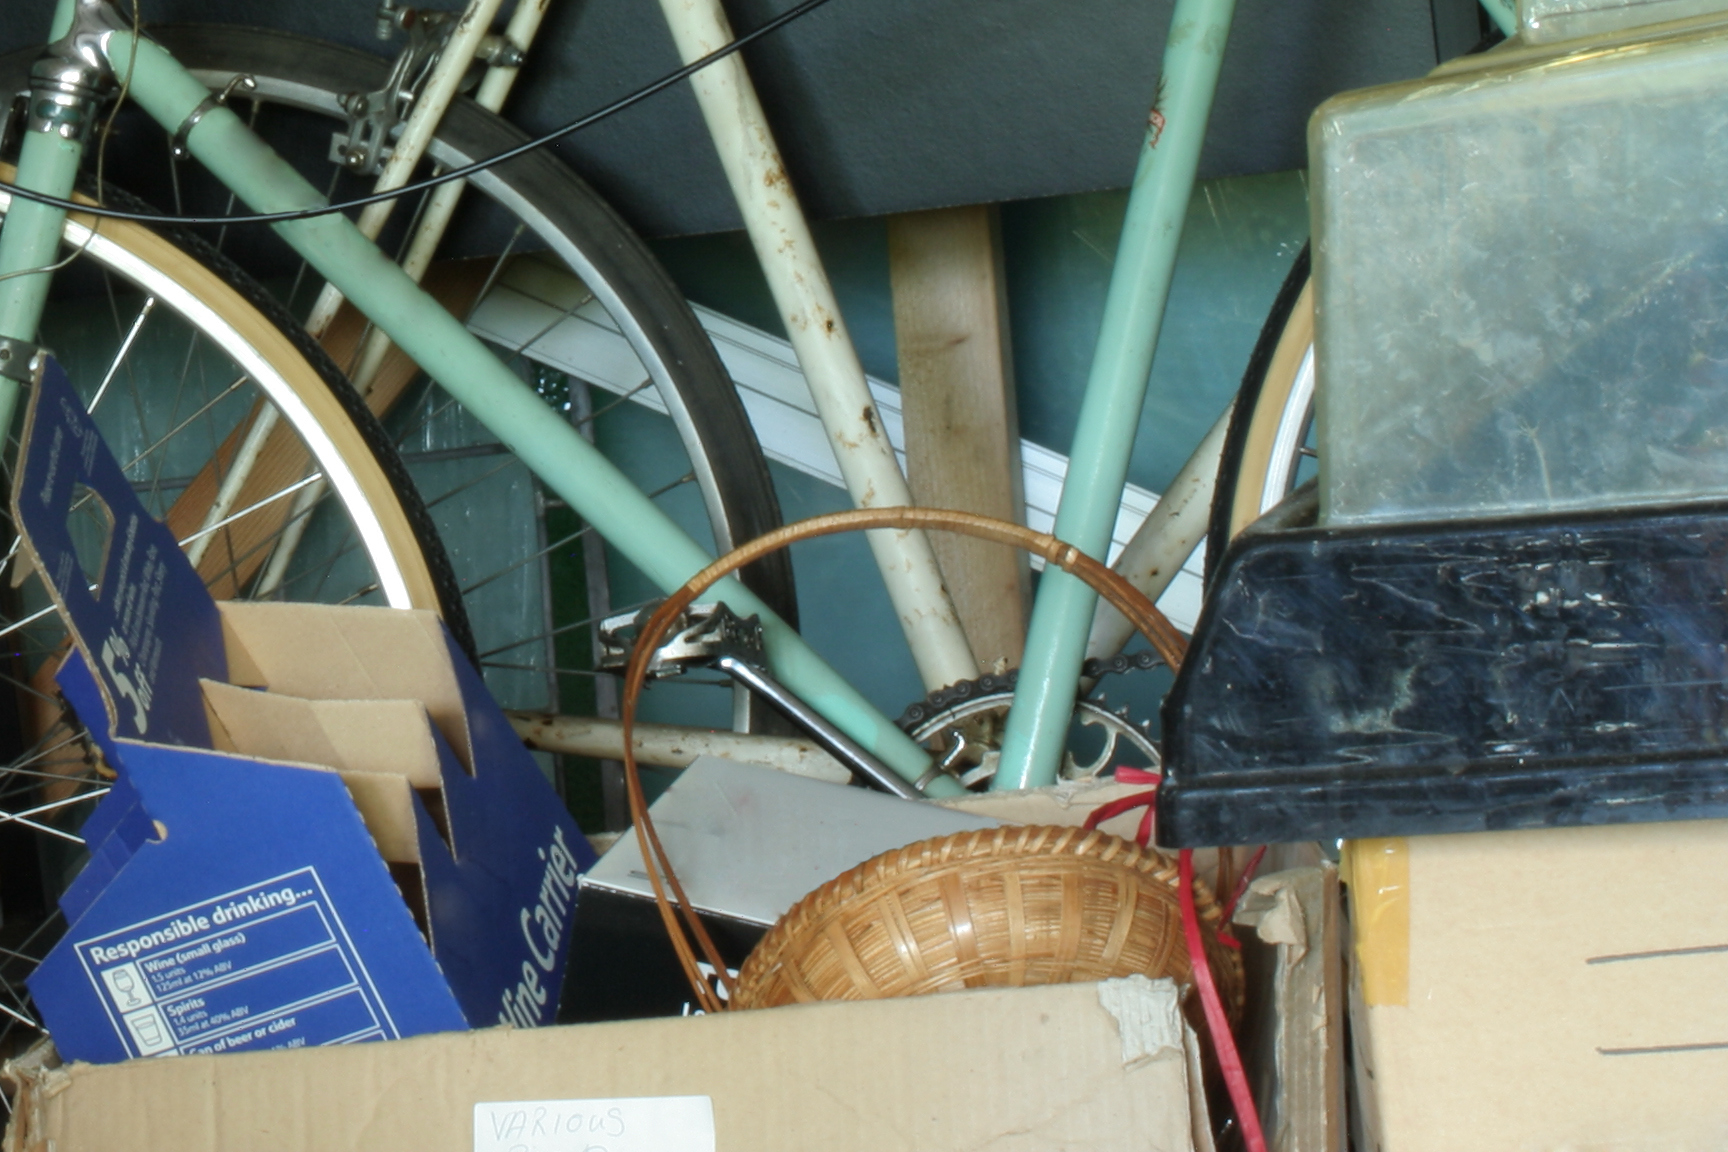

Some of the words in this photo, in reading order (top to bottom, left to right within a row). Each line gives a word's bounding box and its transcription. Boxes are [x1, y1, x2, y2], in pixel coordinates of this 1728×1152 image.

[134, 662, 153, 711] off
[520, 825, 577, 972] Carrier
[90, 915, 210, 964] Responsible
[212, 887, 313, 925] drinking...
[143, 957, 176, 973] Wine
[175, 943, 212, 964] (small
[212, 932, 247, 954] glass)
[164, 967, 187, 979] units
[213, 960, 232, 974] ABV
[166, 997, 206, 1017] Spirits
[186, 1010, 208, 1023] units
[230, 1005, 249, 1019] ABV
[213, 1037, 227, 1052] of
[226, 1031, 253, 1048] beer
[254, 1027, 267, 1039] or
[268, 1017, 296, 1034] cider
